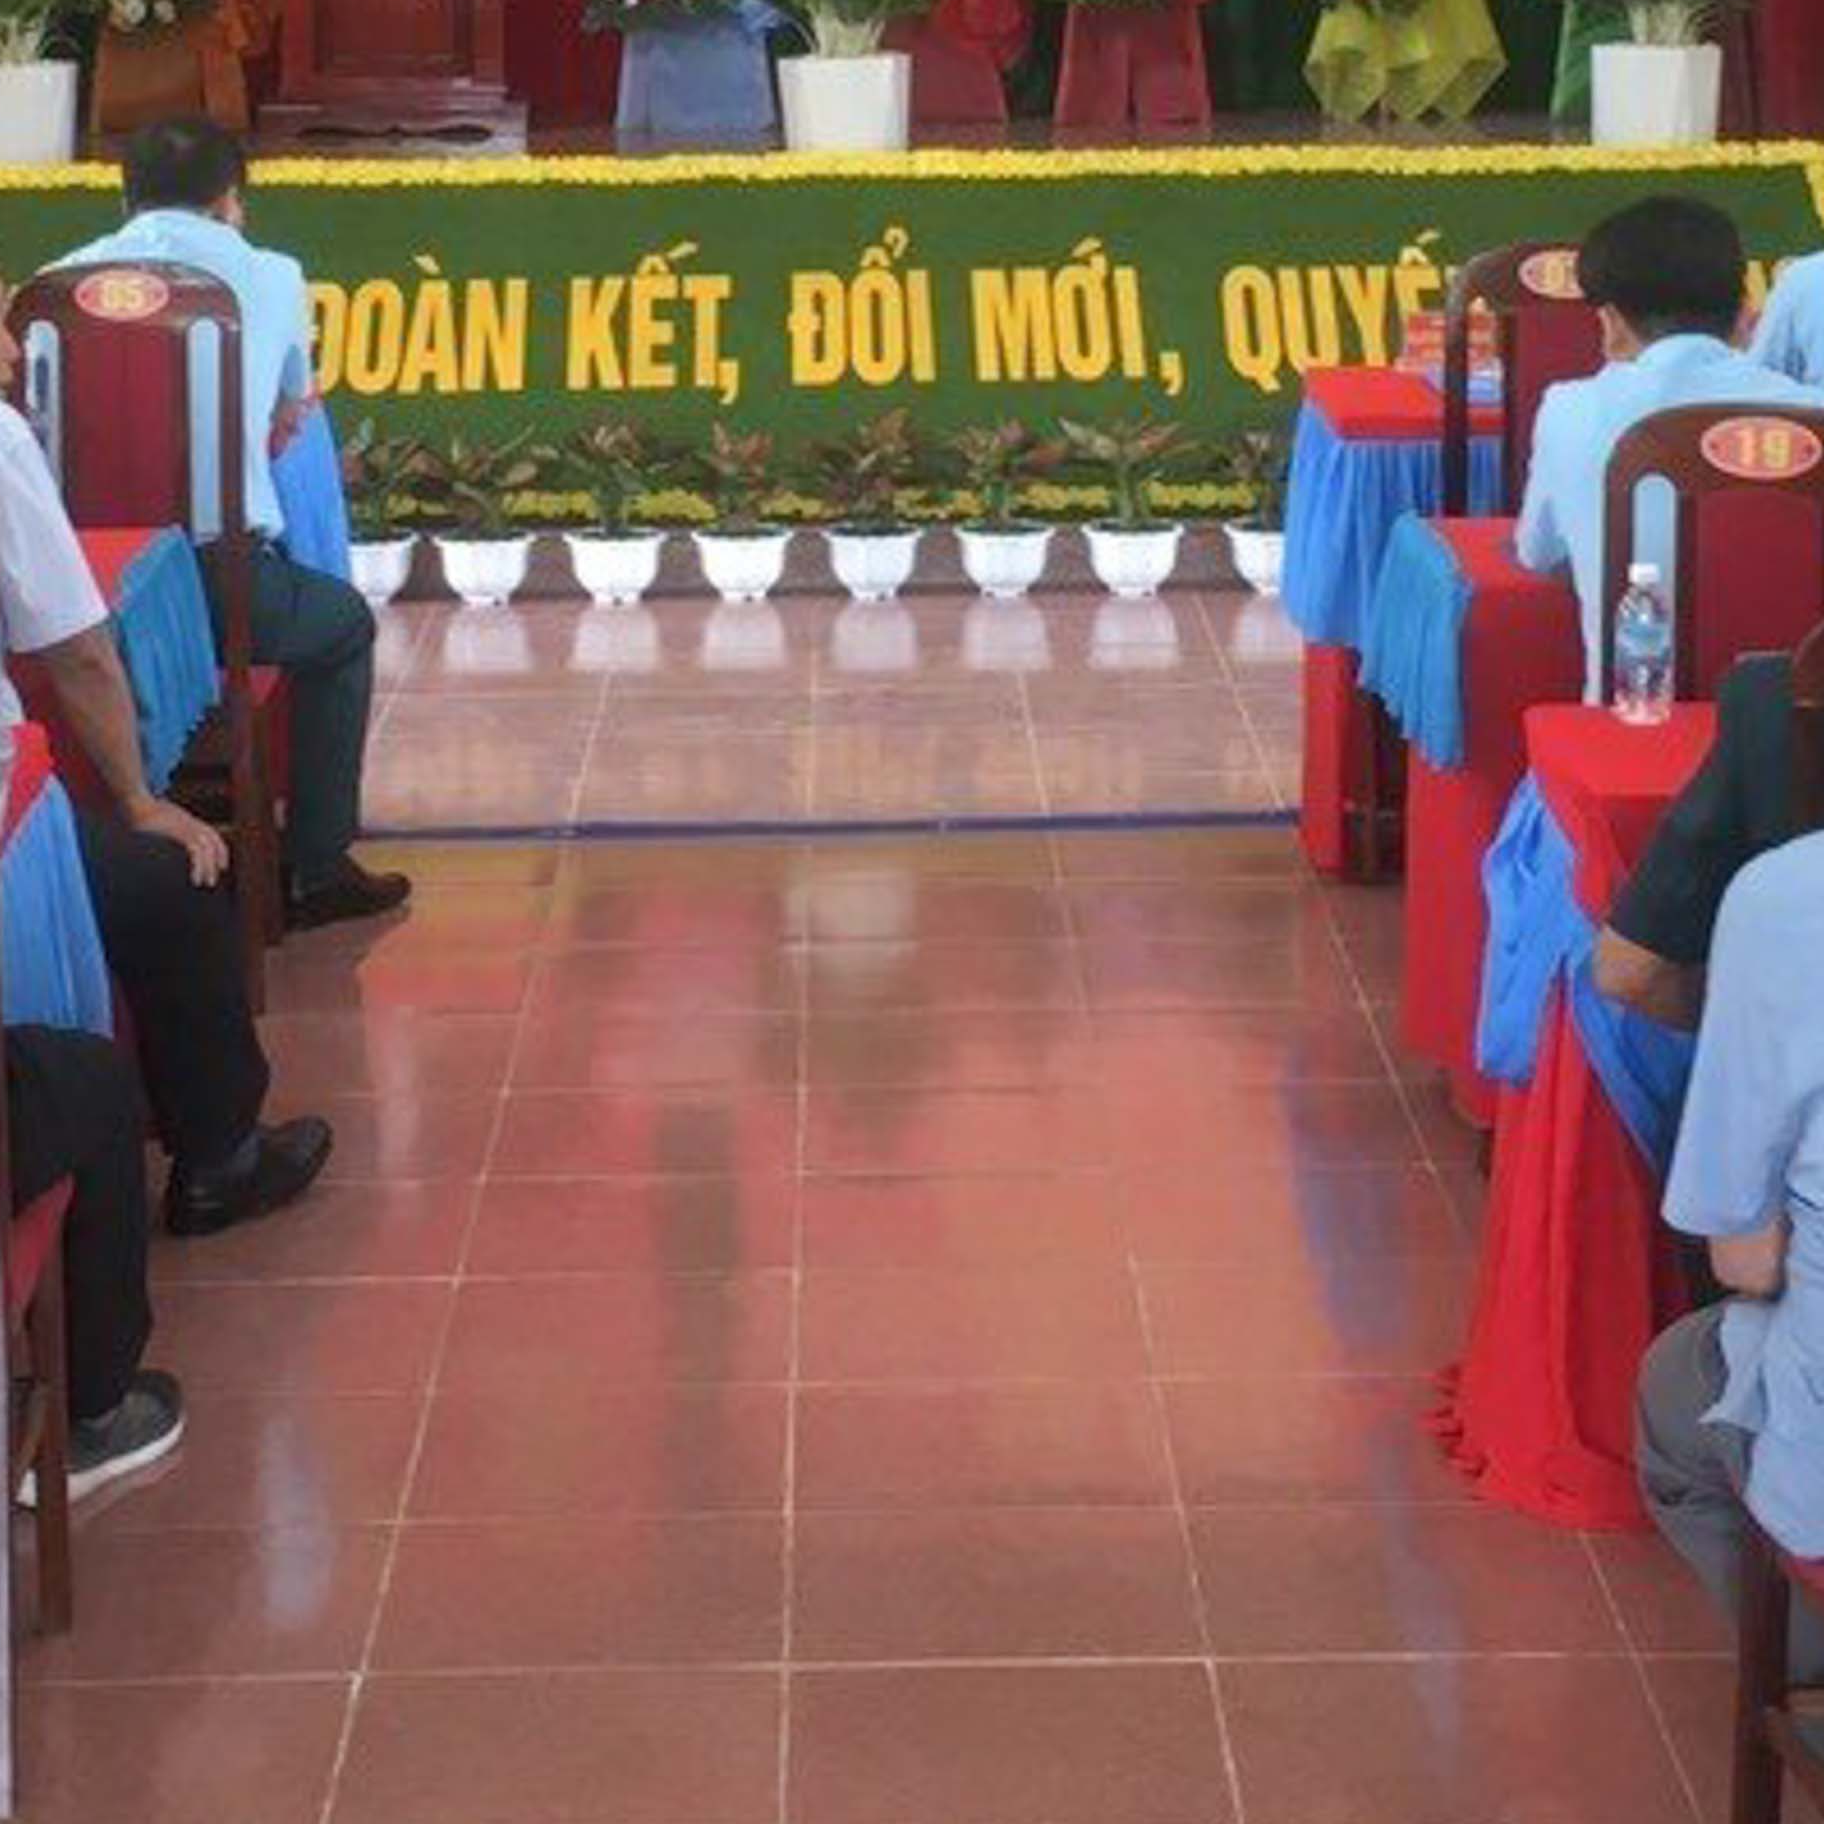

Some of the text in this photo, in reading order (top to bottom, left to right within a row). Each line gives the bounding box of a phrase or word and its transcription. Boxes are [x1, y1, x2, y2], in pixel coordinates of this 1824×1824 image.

[308, 254, 529, 395] ĐOÀN
[565, 241, 740, 405] KẾT,
[787, 226, 936, 386] ĐỔI
[1736, 427, 1790, 468] 19
